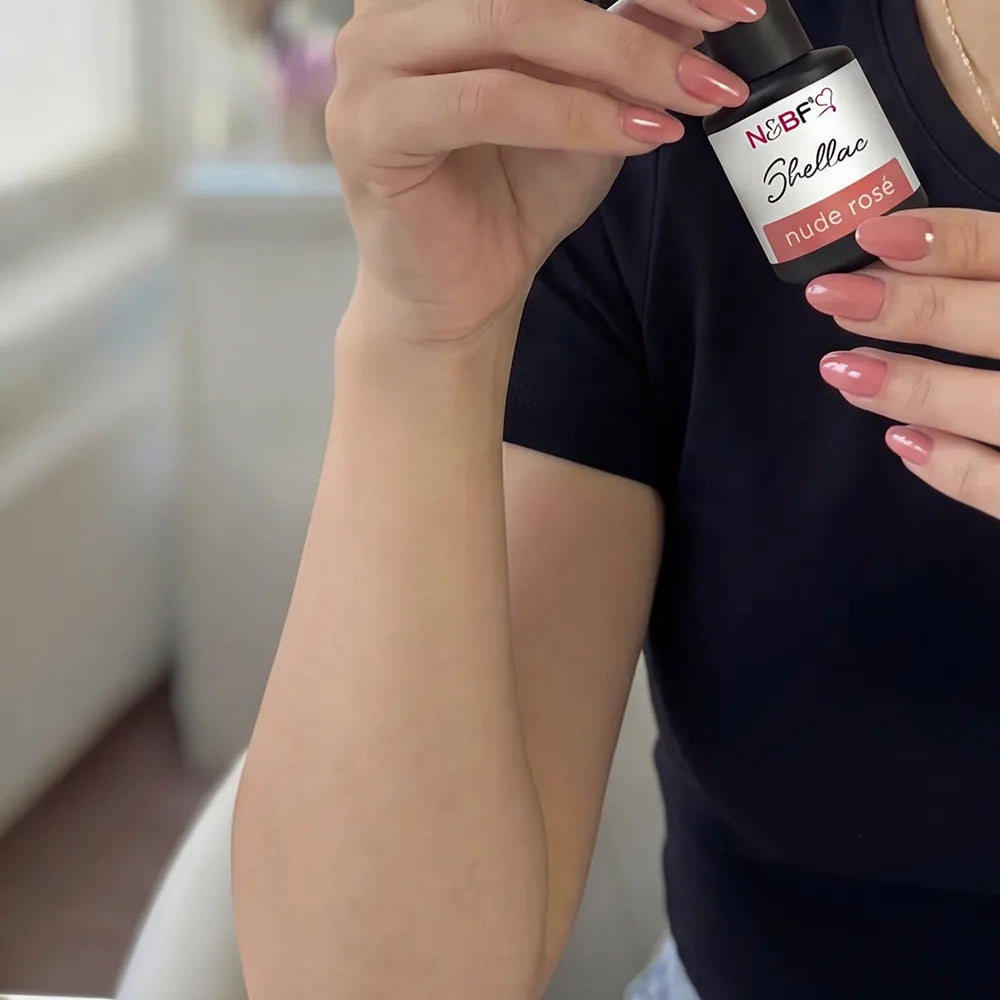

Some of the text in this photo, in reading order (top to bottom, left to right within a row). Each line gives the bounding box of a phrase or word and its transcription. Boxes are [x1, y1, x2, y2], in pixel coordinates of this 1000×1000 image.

[763, 138, 868, 203] Shellac
[785, 175, 896, 247] nude rosé
